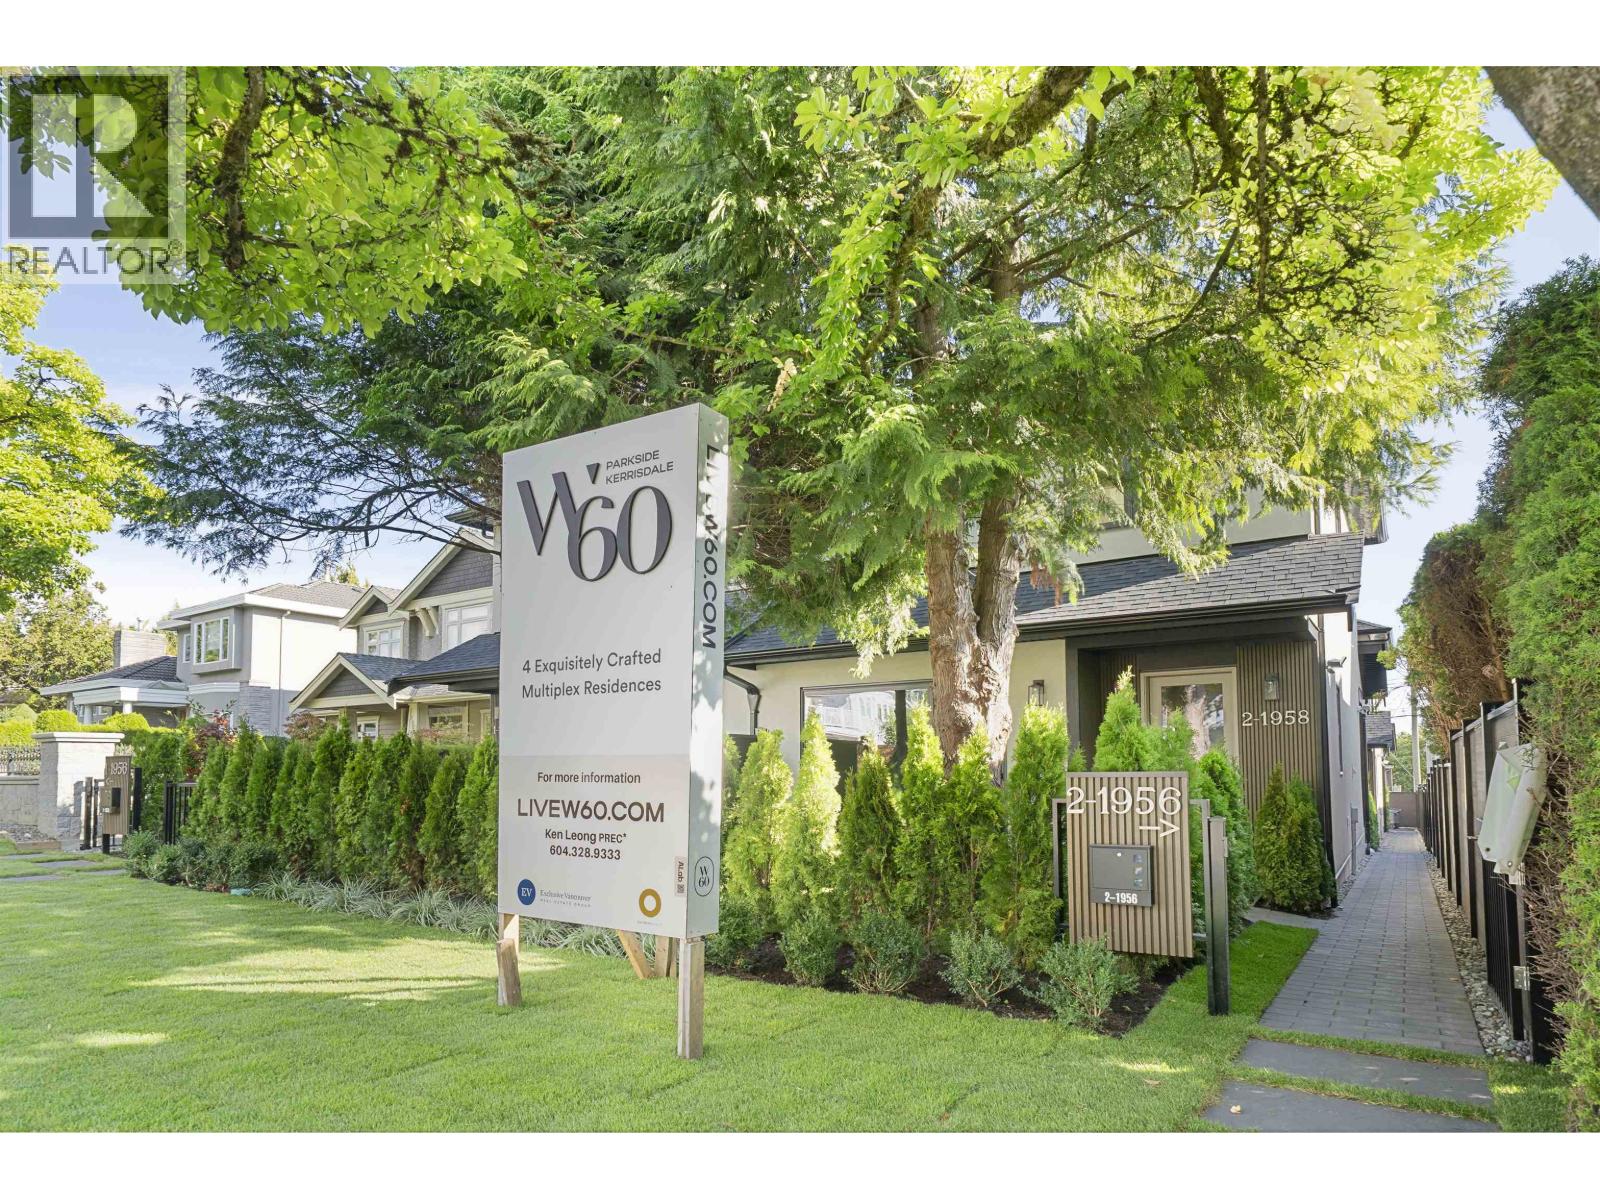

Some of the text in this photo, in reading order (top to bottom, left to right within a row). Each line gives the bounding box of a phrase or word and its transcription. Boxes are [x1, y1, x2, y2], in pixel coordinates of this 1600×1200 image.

[606, 450, 660, 470] PARKSIDE
[605, 461, 674, 484] KERRISDALE
[702, 444, 721, 649] LIW60.COM
[522, 648, 661, 674] 4 Exquisitely Crafted
[522, 679, 661, 699] Multiplex Residences
[1242, 710, 1310, 726] 2-1958
[537, 772, 641, 783] For more information
[517, 798, 664, 823] LIVEW60.COM
[1067, 787, 1182, 815] 2-1956
[545, 829, 563, 840] Ken
[565, 830, 597, 844] Leong
[549, 845, 621, 860] 604.328.9333
[521, 887, 532, 897] EV
[1104, 891, 1138, 904] 2-1956
